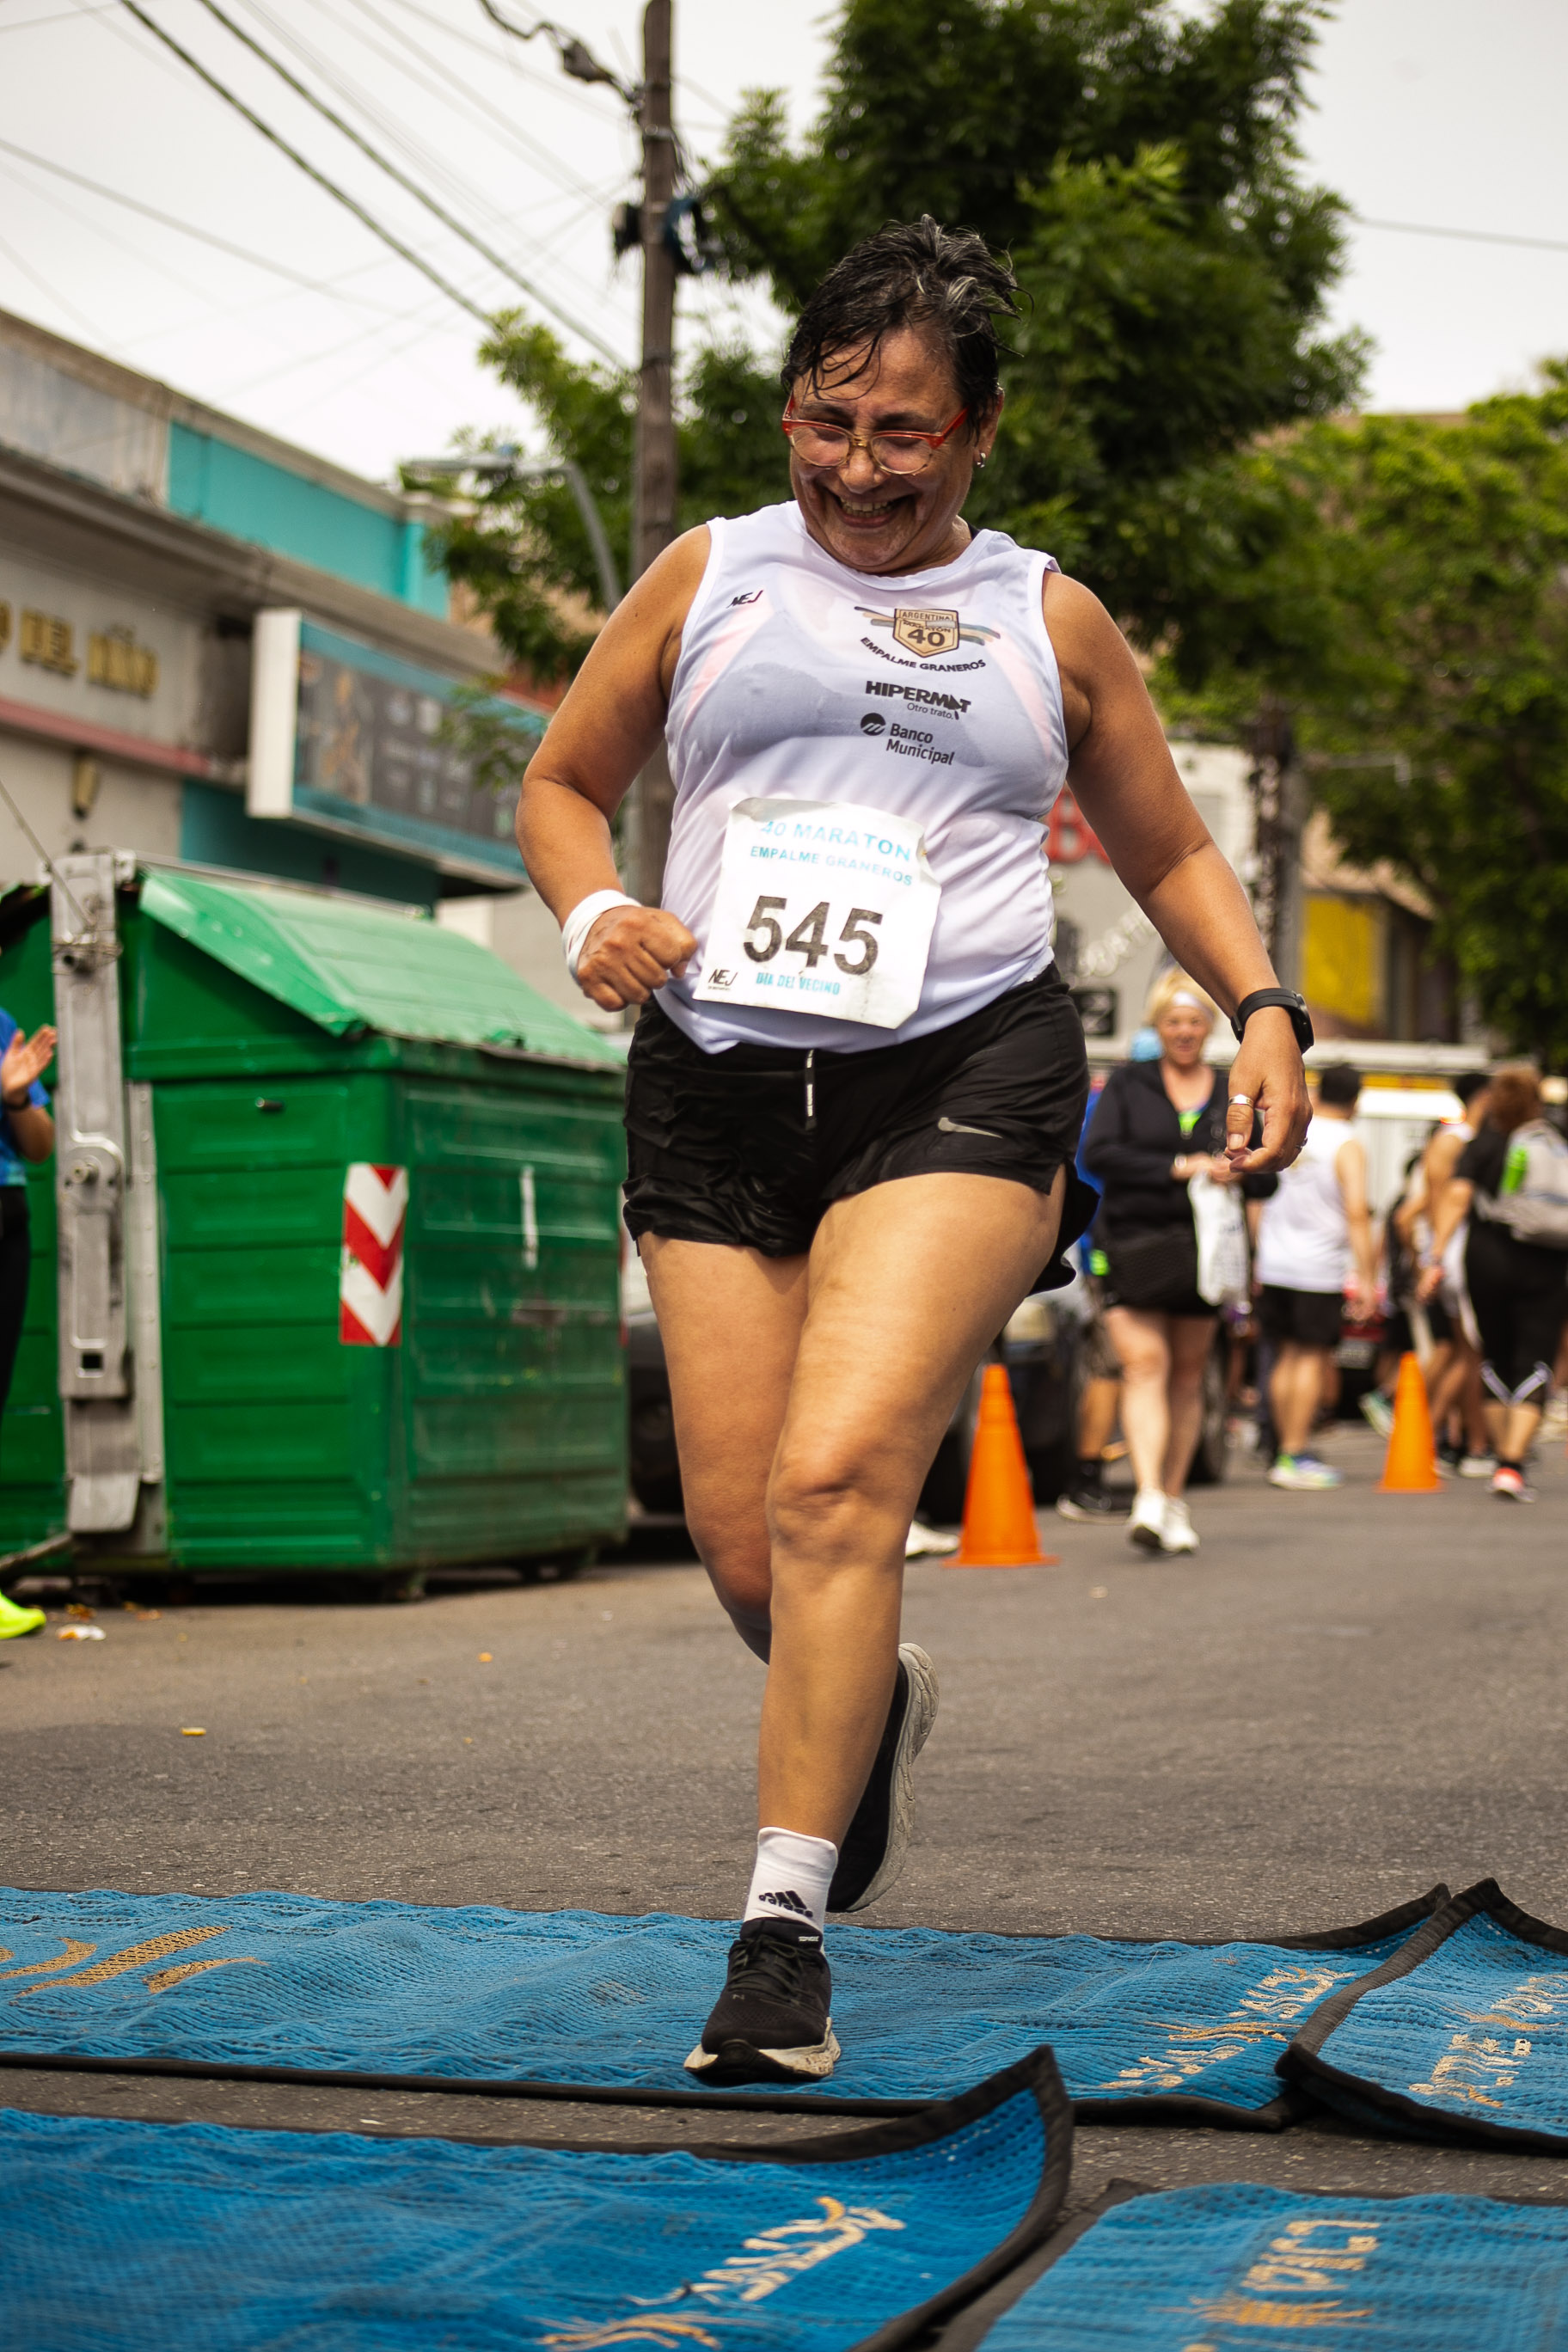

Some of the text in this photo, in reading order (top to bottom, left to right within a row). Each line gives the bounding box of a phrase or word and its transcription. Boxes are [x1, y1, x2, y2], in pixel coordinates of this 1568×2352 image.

[902, 611, 951, 621] ARGENTINA
[907, 628, 946, 646] 40
[860, 636, 987, 673] EMPALME GRANEROS
[907, 702, 928, 714] Otro
[890, 723, 934, 744] Banco
[886, 738, 956, 766] Municipal
[760, 821, 911, 861] 40 MARATON
[750, 846, 913, 886] EMPALME GRANEROS
[743, 895, 884, 976] 545
[799, 977, 841, 995] VECINO
